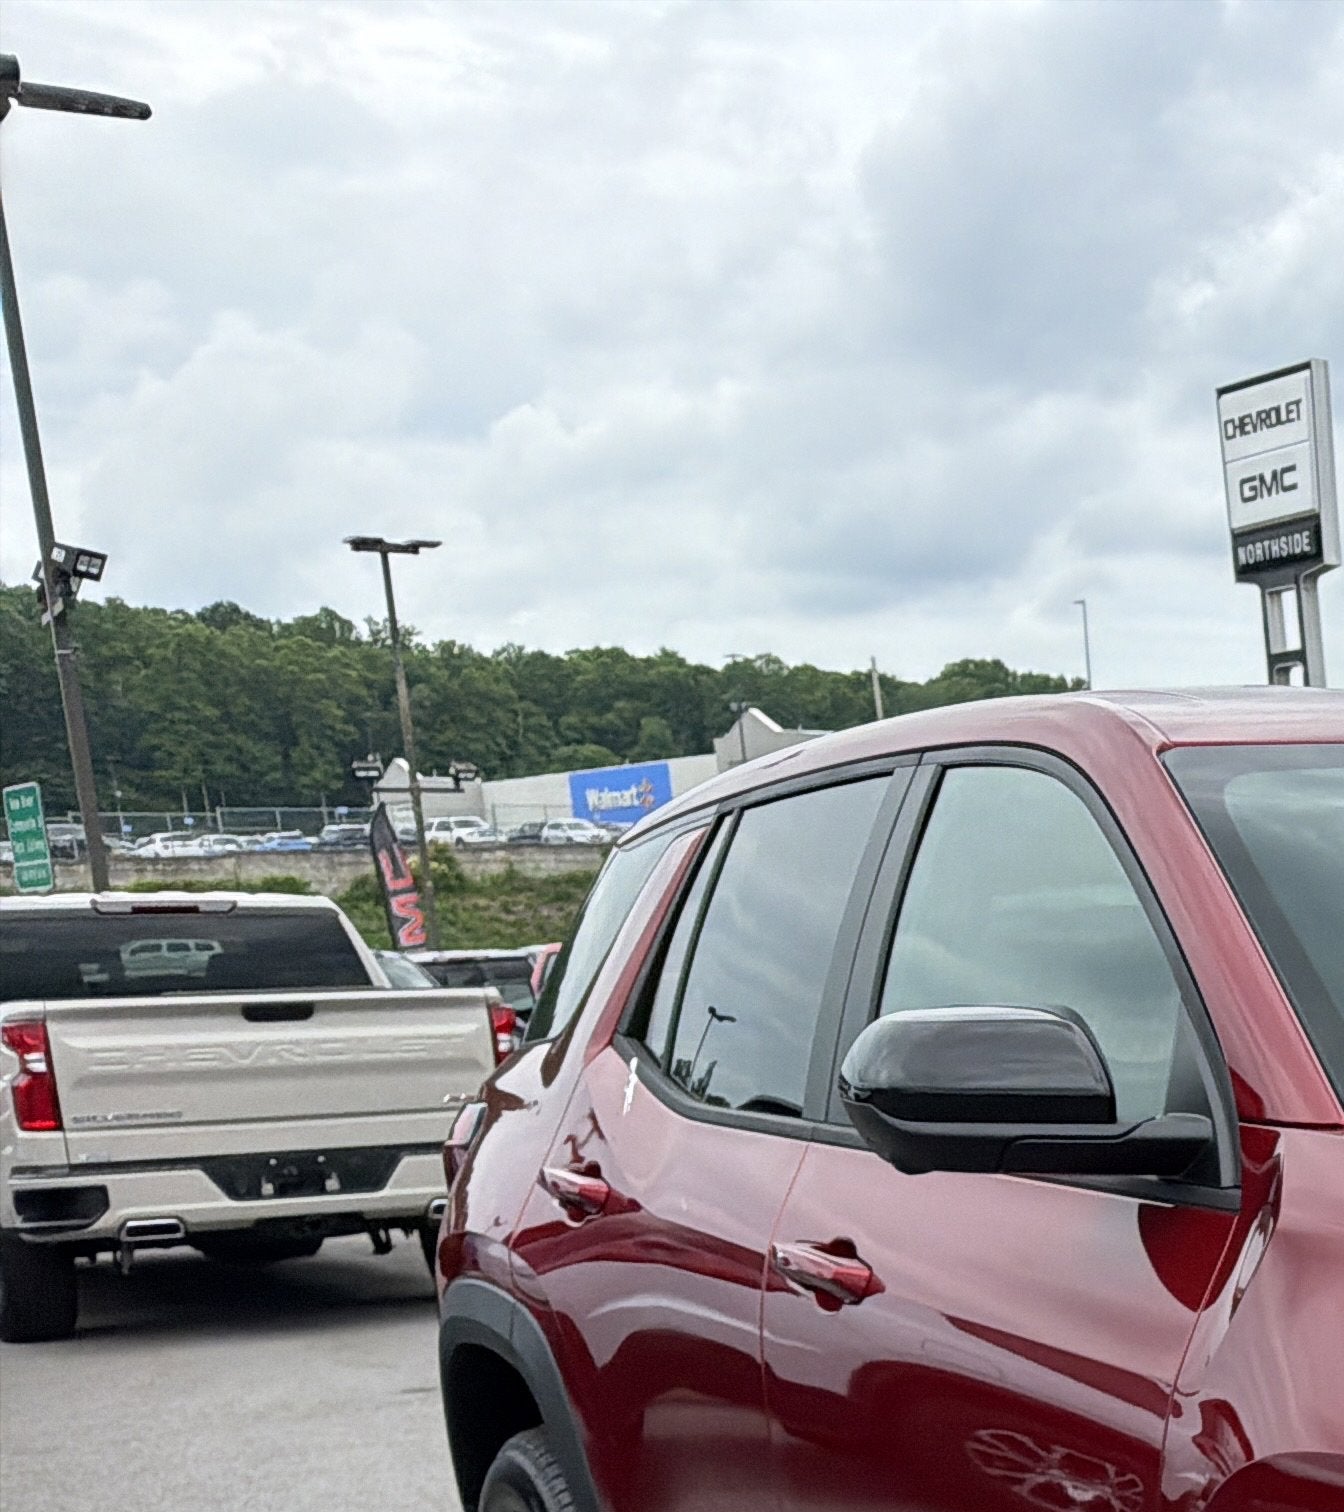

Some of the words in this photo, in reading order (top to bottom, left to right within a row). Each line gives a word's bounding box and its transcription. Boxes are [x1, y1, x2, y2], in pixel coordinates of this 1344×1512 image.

[1223, 398, 1303, 441] CHEVROLET
[1239, 464, 1298, 503] GMC
[1237, 530, 1312, 567] NORTHSIDE
[585, 784, 639, 812] Walmart
